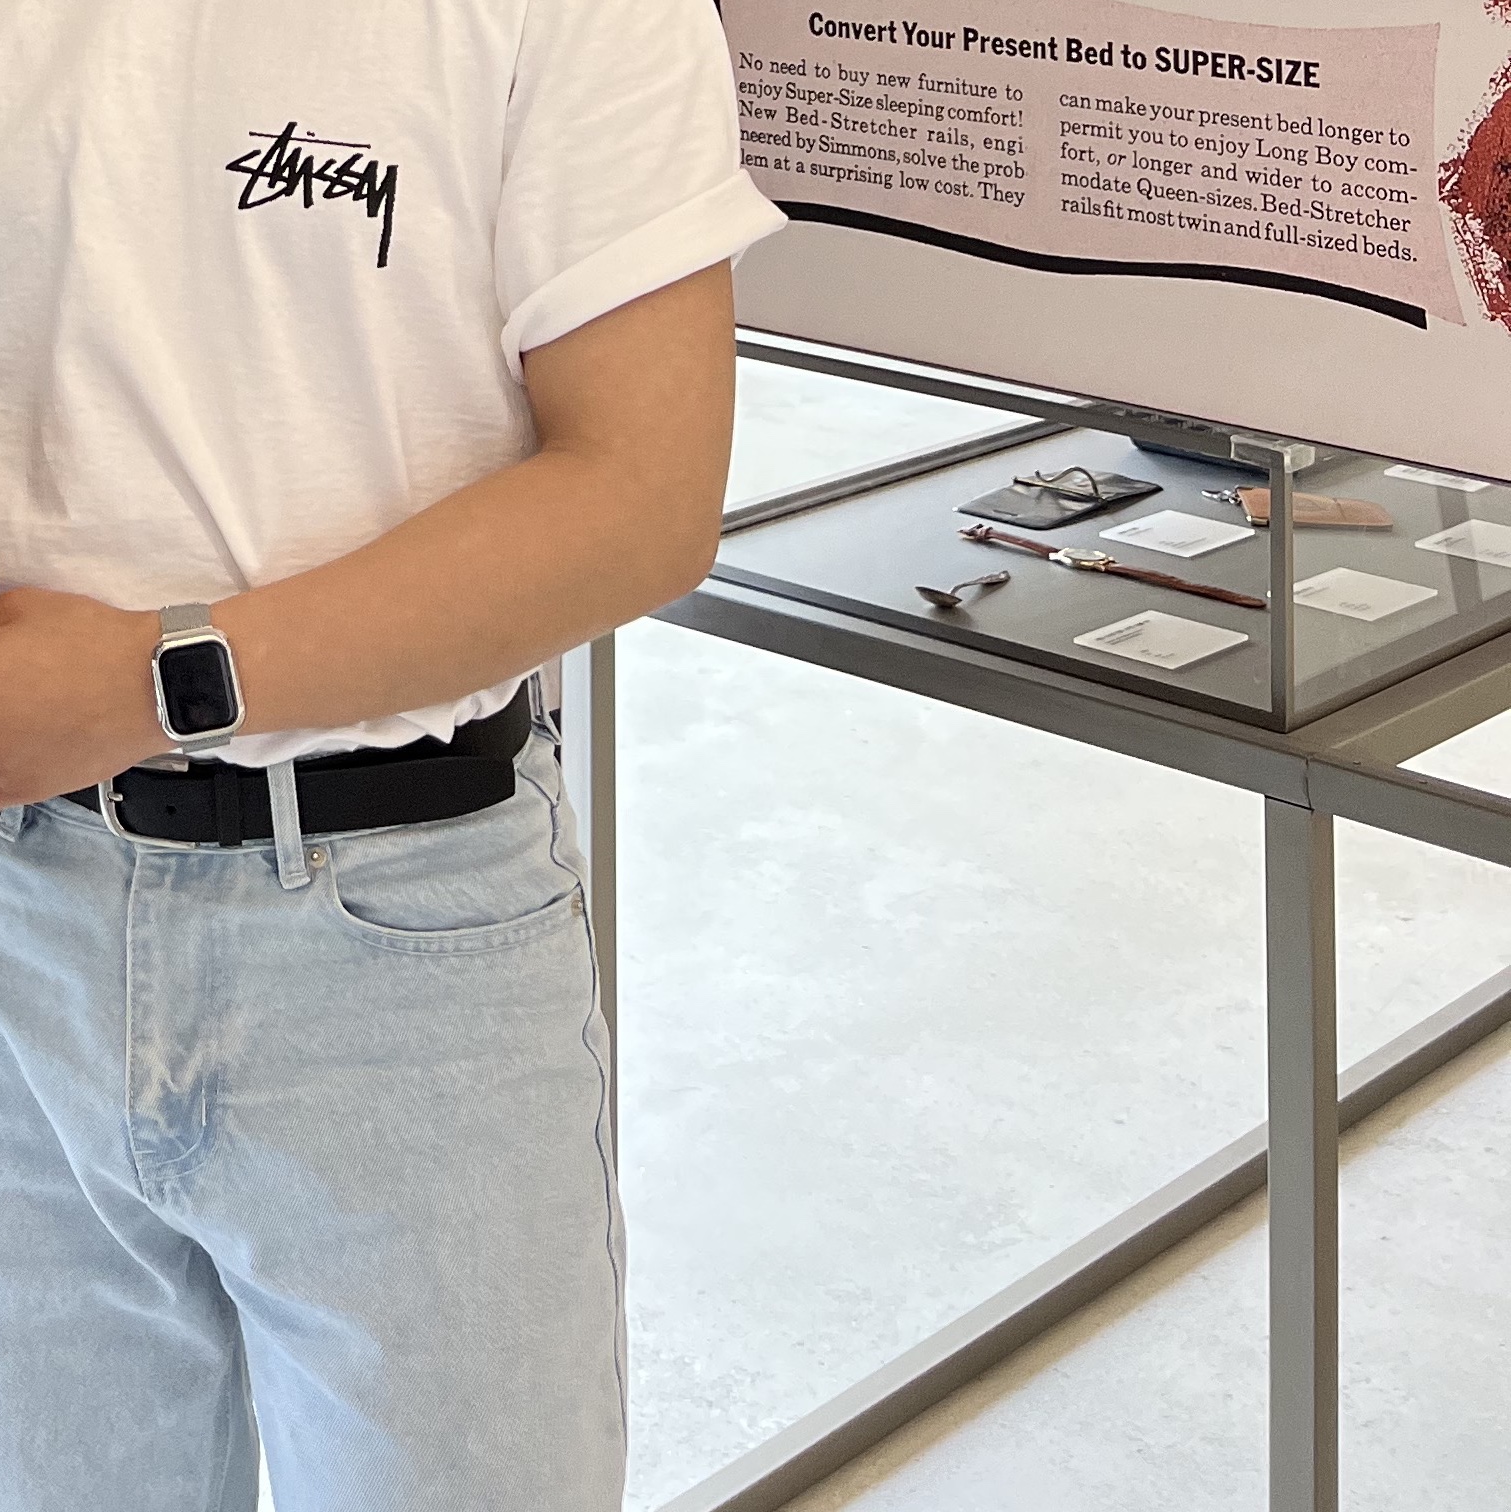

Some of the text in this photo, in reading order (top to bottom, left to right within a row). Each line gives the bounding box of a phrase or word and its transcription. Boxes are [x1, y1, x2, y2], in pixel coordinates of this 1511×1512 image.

[739, 52, 1023, 101] No need to buy new furniture to
[808, 12, 1320, 89] Convert Your Present Bed to SUPER-SIZE
[739, 78, 1023, 128] enjoy Super-Size sleeping comfort!
[1059, 94, 1410, 147] can make your present bed longer to
[1059, 120, 1418, 175] permit you to enjoy Long Boy com-
